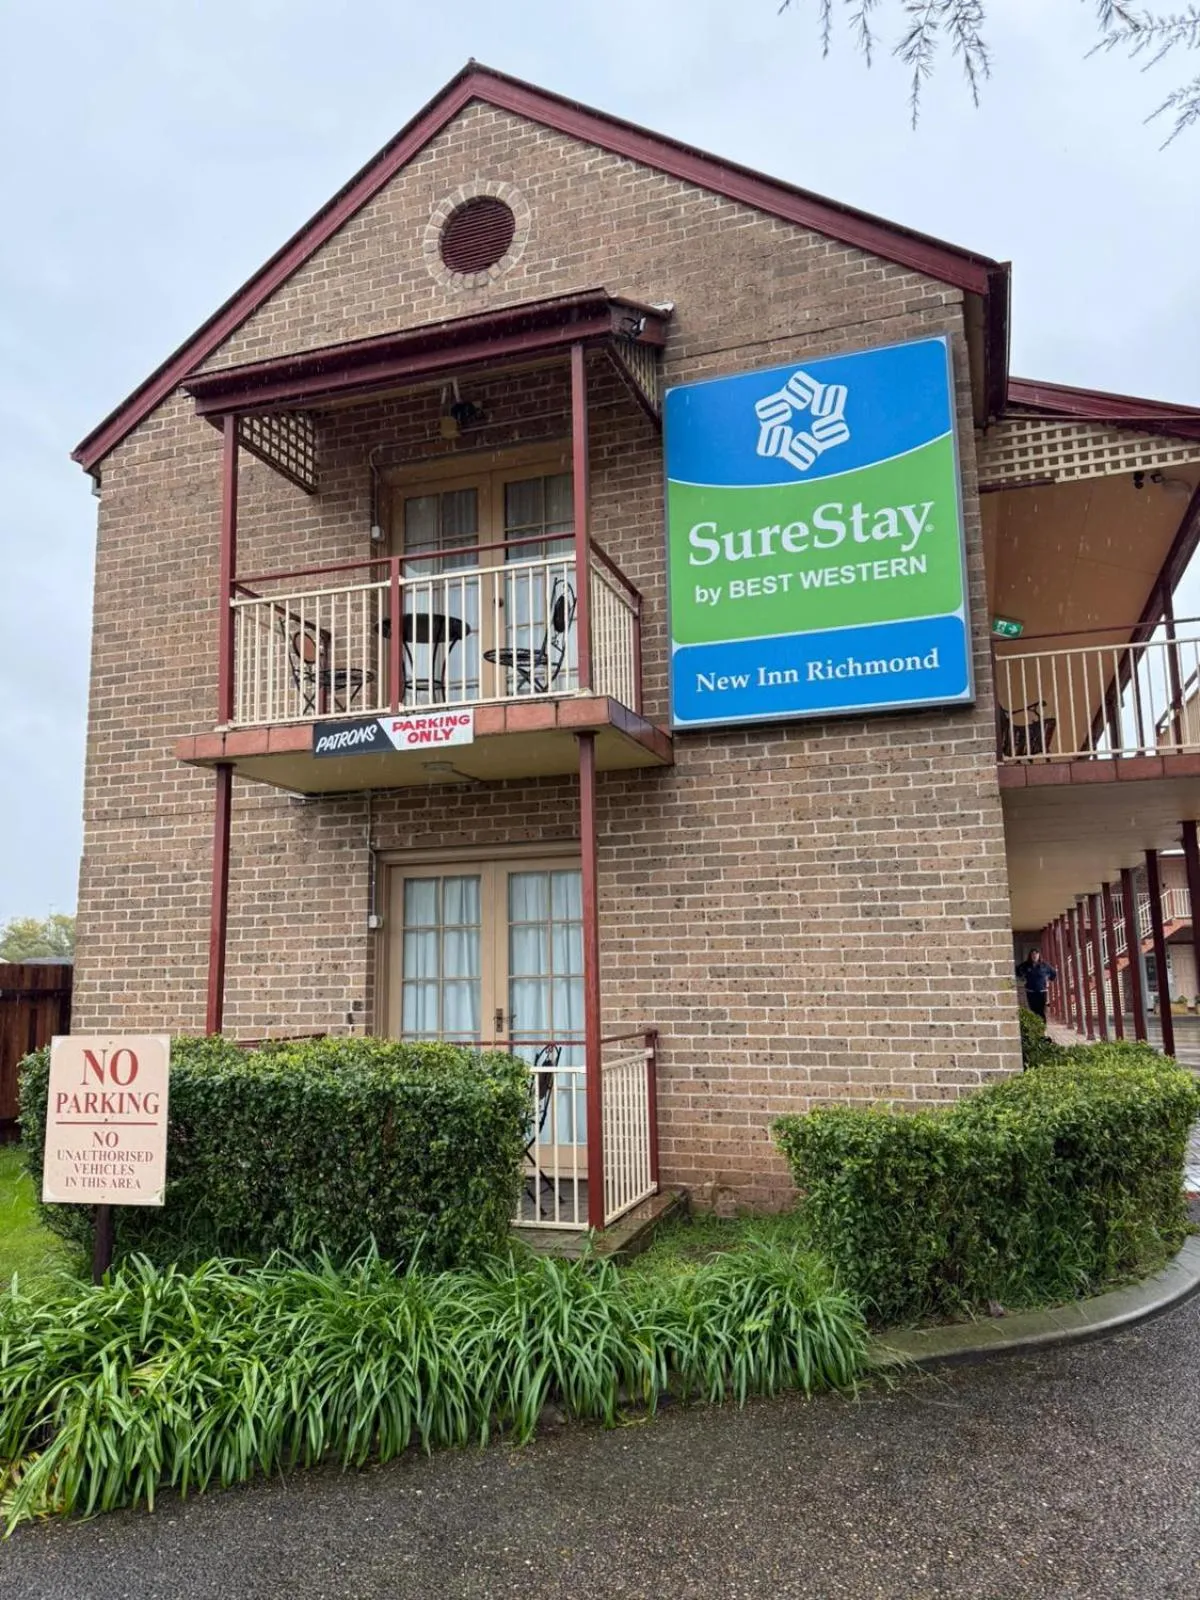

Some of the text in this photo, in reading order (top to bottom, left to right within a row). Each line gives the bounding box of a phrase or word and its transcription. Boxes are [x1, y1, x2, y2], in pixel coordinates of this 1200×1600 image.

[689, 501, 934, 566] SureStay
[695, 555, 927, 606] by BEST WESTERN
[696, 648, 940, 692] New Inn Richmond
[392, 715, 470, 732] PARKING
[316, 724, 377, 752] PATRONS
[407, 728, 454, 743] ONLY
[80, 1048, 138, 1086] NO
[56, 1092, 160, 1115] PARKING
[92, 1131, 119, 1148] NO
[57, 1150, 154, 1163] UNAUTHORISED
[74, 1163, 135, 1175] VEHICLES
[65, 1177, 141, 1189] IN THIS AREA
